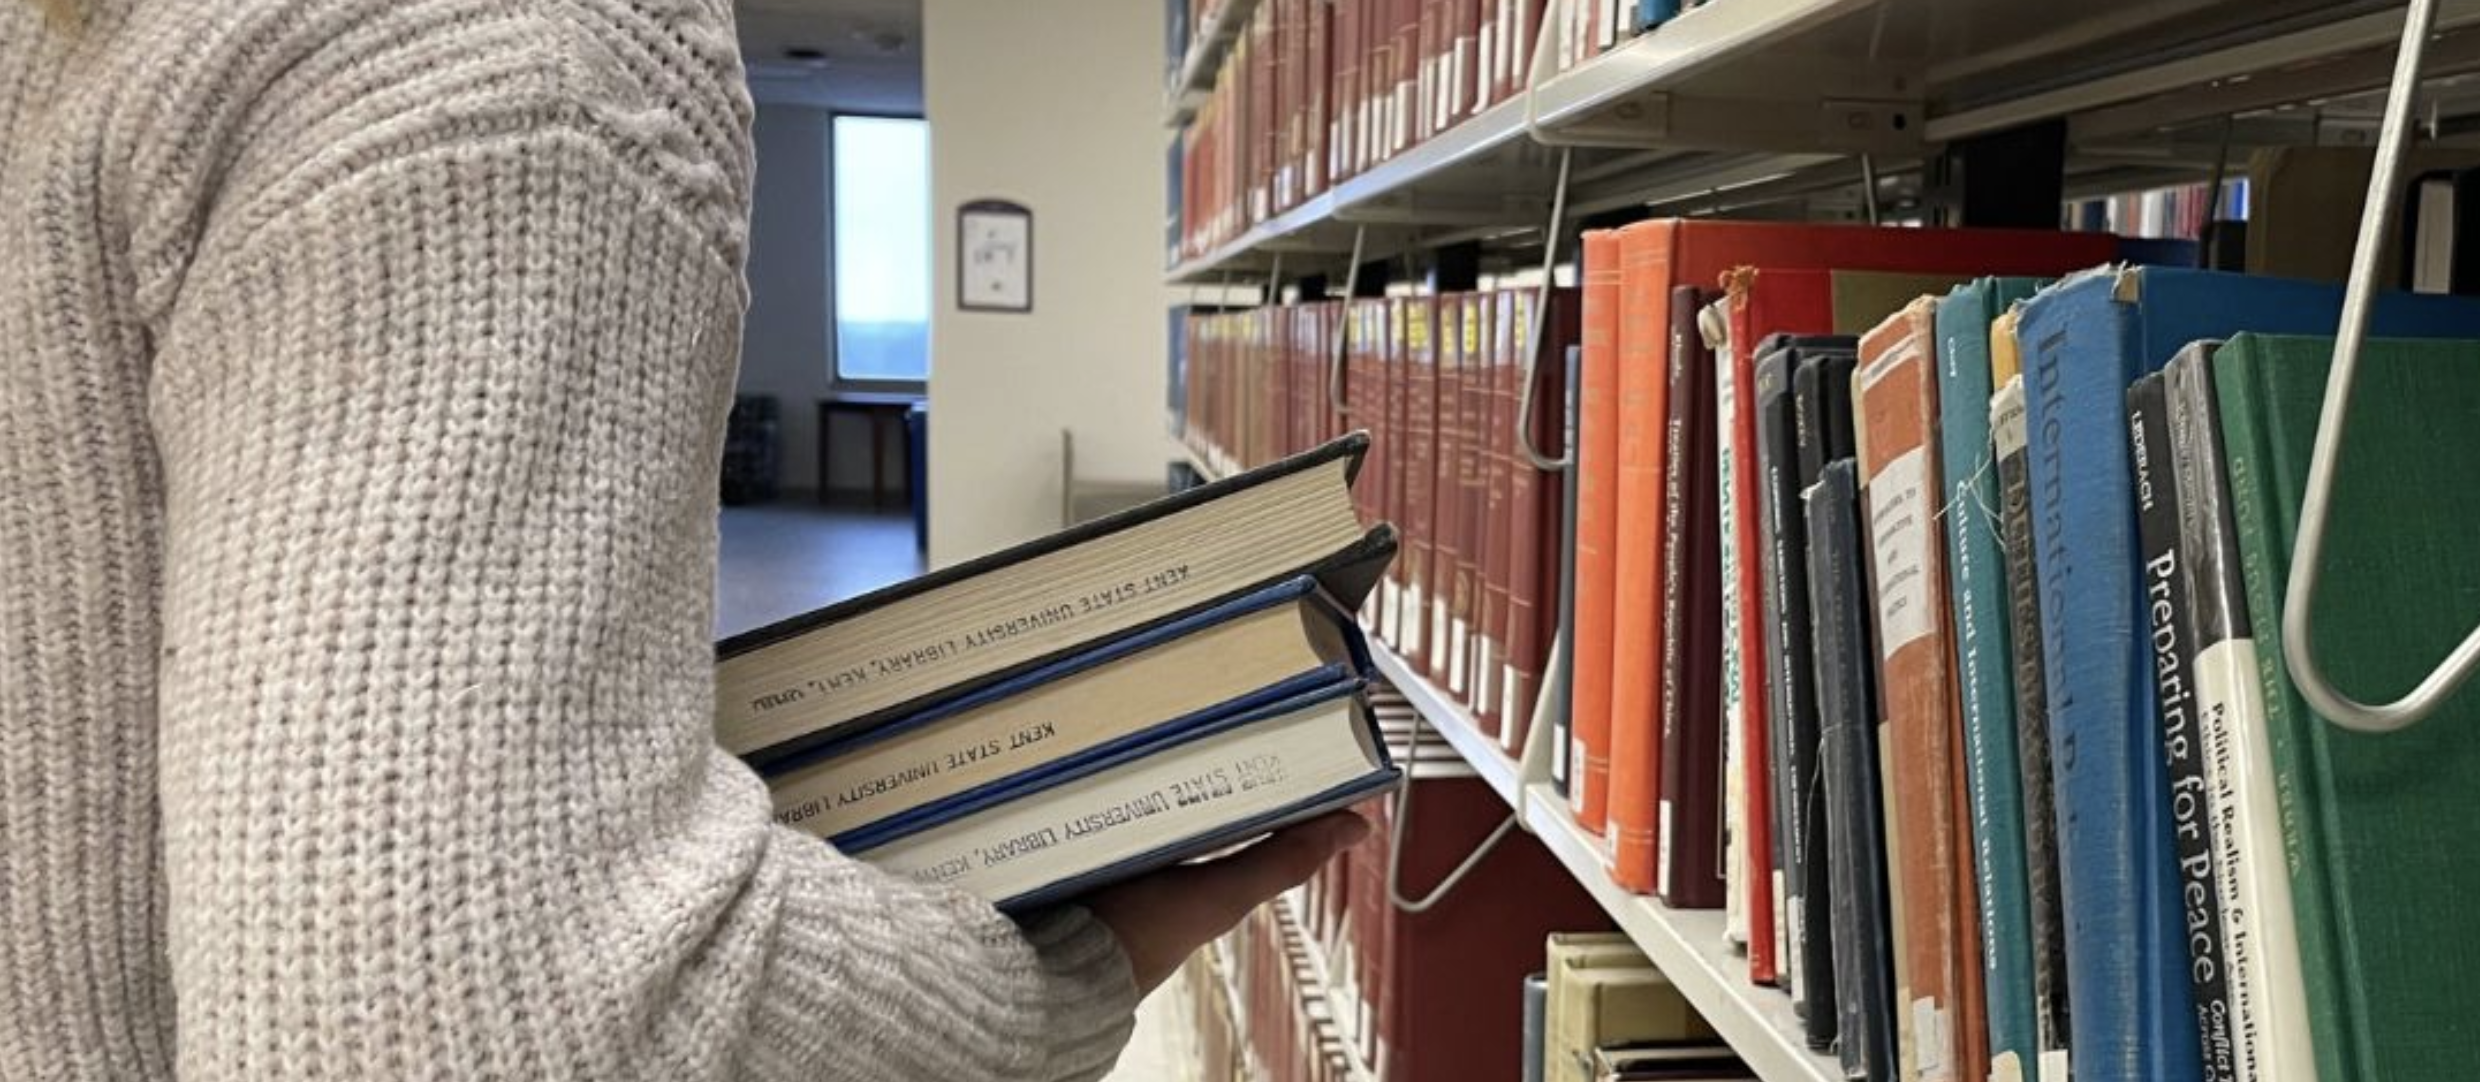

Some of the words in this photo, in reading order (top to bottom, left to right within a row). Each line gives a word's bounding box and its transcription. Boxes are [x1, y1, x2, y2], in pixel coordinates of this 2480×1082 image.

[1079, 582, 1137, 609] STATE
[1144, 564, 1190, 595] KENT
[965, 603, 1075, 650] UNIVERSITY
[1962, 588, 1975, 641] and
[2146, 549, 2191, 766] Preparing
[949, 740, 1001, 769] STATE
[1010, 722, 1055, 751] KENT
[1968, 645, 1986, 826] International
[2211, 702, 2235, 800] Political
[774, 796, 831, 824] LIBRA
[837, 763, 940, 803] UNIVERSITY
[2173, 776, 2204, 841] for
[1064, 790, 1170, 839] UNIVERSITY
[2221, 805, 2239, 901] Realism
[1981, 837, 1998, 969] Relations
[2181, 849, 2215, 985] Peace
[2210, 999, 2230, 1071] Conflict
[2234, 930, 2257, 1082] Internationa
